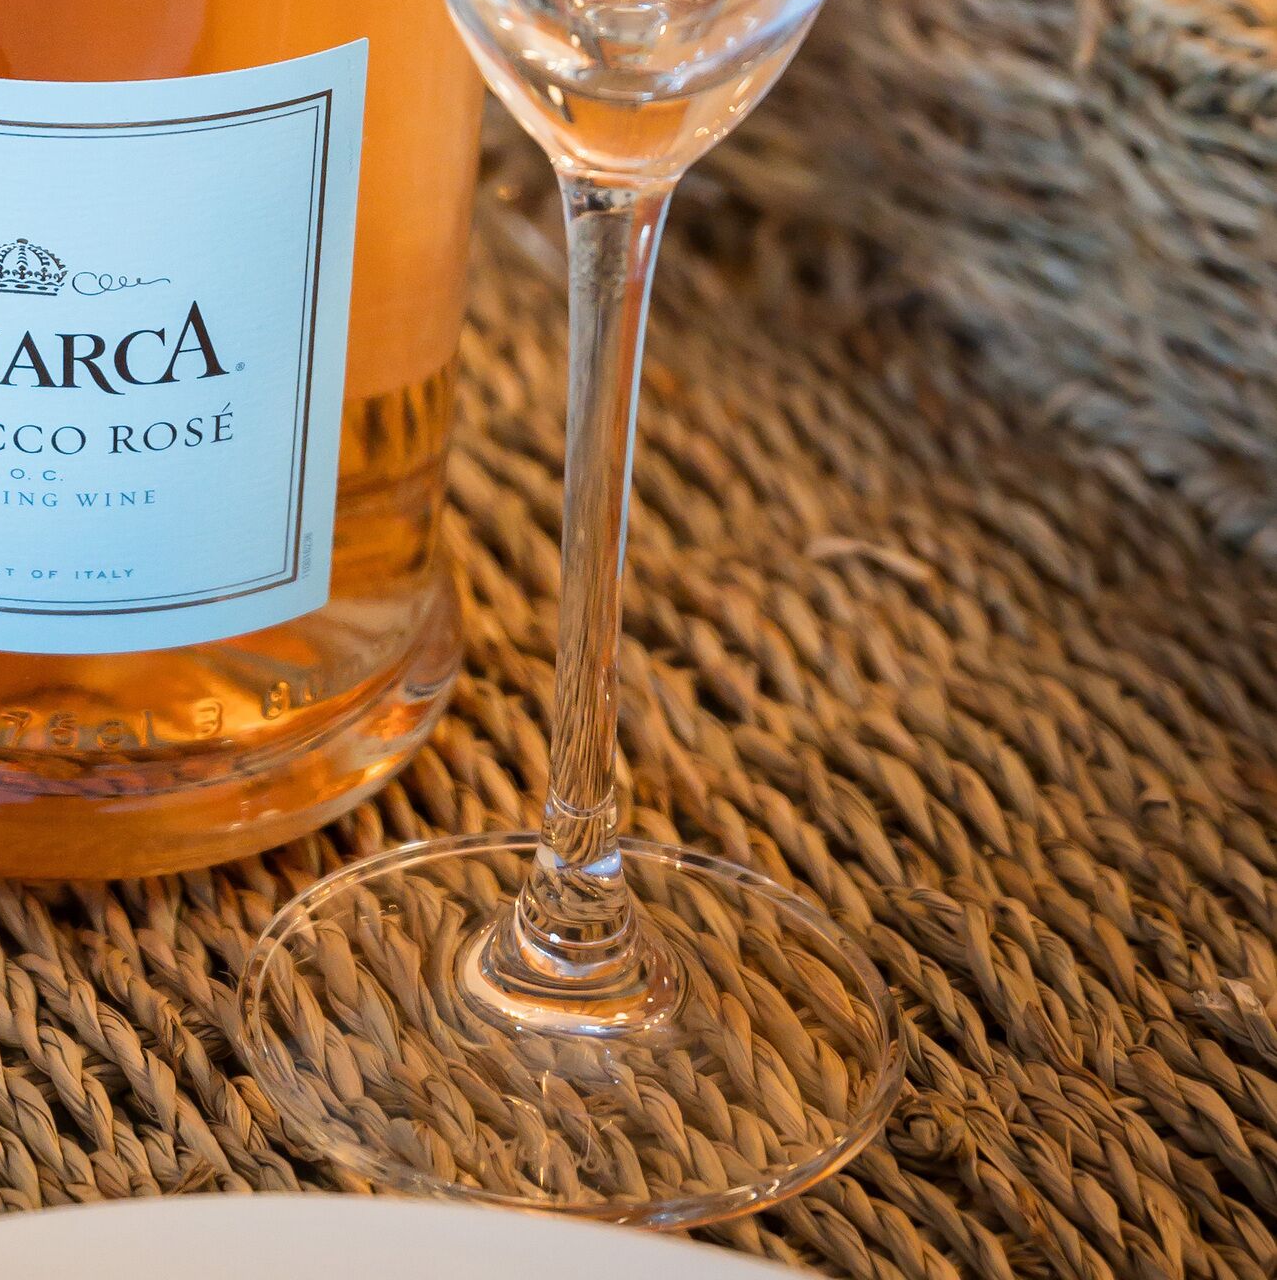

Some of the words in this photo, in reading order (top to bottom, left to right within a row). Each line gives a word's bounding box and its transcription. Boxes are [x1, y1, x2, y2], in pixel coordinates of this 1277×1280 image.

[108, 402, 234, 455] ROSÉ
[76, 489, 156, 508] WINE
[31, 568, 58, 580] OF
[74, 568, 135, 580] ITALY
